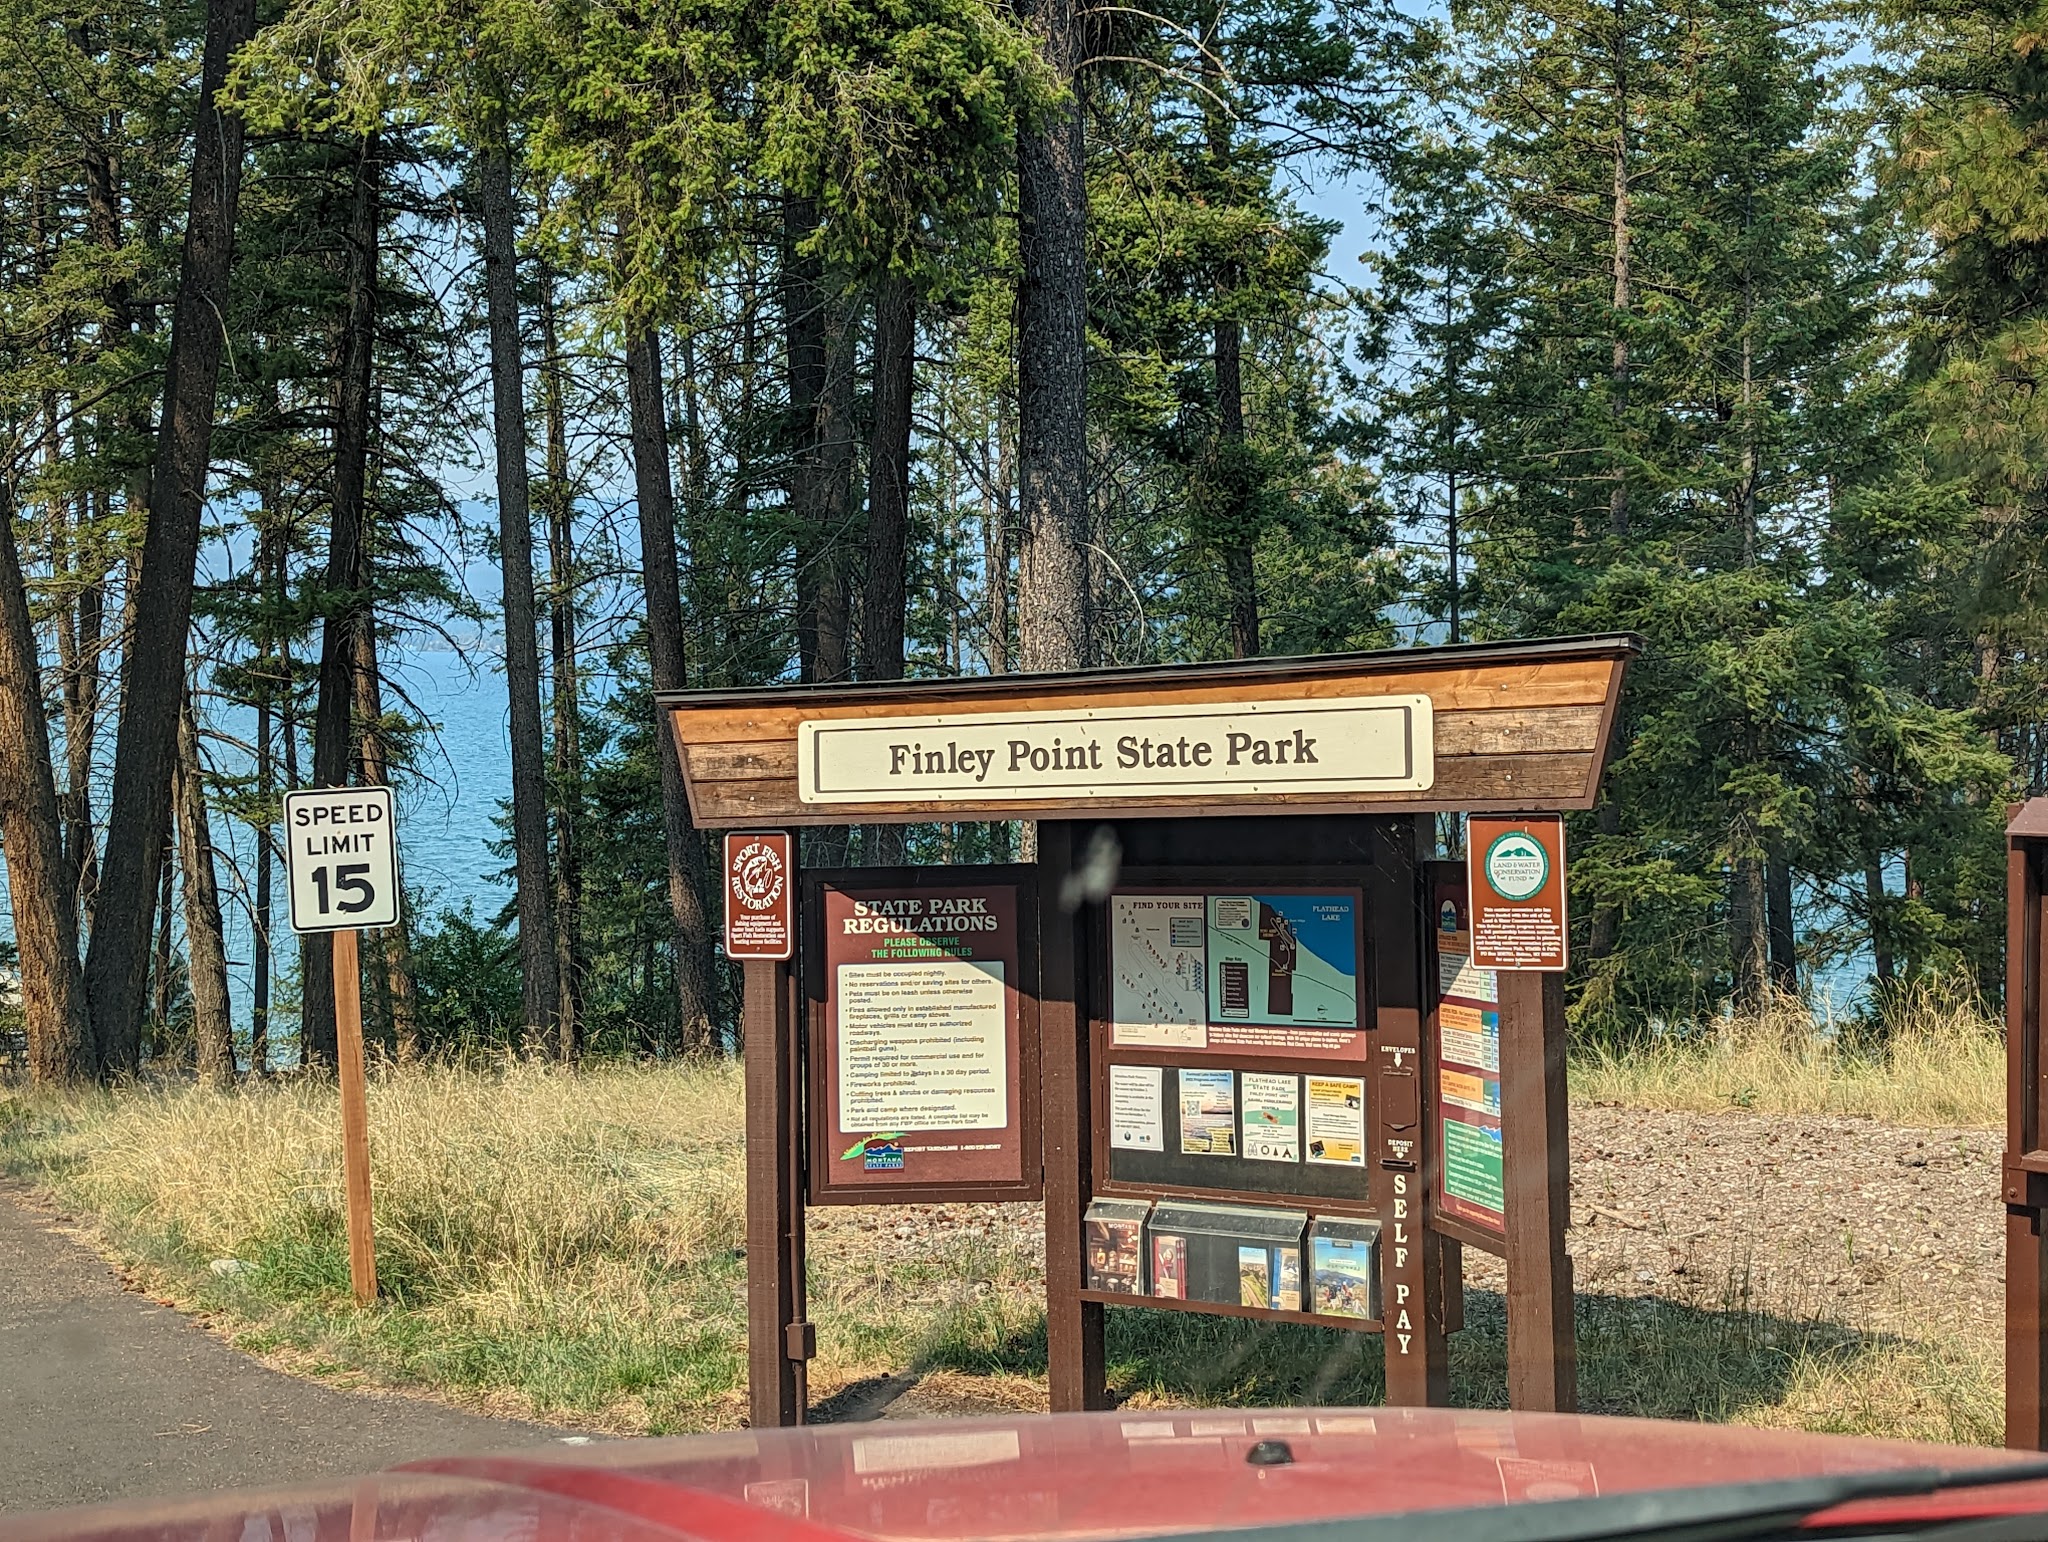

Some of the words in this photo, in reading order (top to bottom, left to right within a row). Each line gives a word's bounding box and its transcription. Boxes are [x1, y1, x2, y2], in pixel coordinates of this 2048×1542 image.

[889, 743, 994, 782] Finley
[1008, 735, 1102, 772] Point
[1117, 731, 1211, 770] State
[1226, 730, 1318, 766] Park
[295, 804, 383, 826] SPEED
[307, 833, 374, 856] LIMIT
[733, 843, 760, 873] SPORT
[762, 845, 782, 872] FISH
[311, 863, 375, 914] 15
[732, 875, 783, 910] RESTORATION
[854, 899, 923, 916] STATE
[929, 898, 987, 915] PARK
[1184, 902, 1203, 910] SITE
[1312, 905, 1349, 913] FLATHEAD
[843, 915, 998, 934] REGULATIONS
[884, 938, 917, 947] PLEASE
[920, 937, 960, 946] OBSERVE
[871, 949, 888, 958] THE
[891, 948, 942, 958] FOLLOWING
[944, 947, 972, 957] RULES
[1381, 1046, 1415, 1055] ENVELOPES
[1387, 1139, 1414, 1147] DEPOSIT
[1108, 1222, 1136, 1230] MONTANA
[1394, 1175, 1408, 1268] SELF
[1396, 1284, 1412, 1354] PAY
